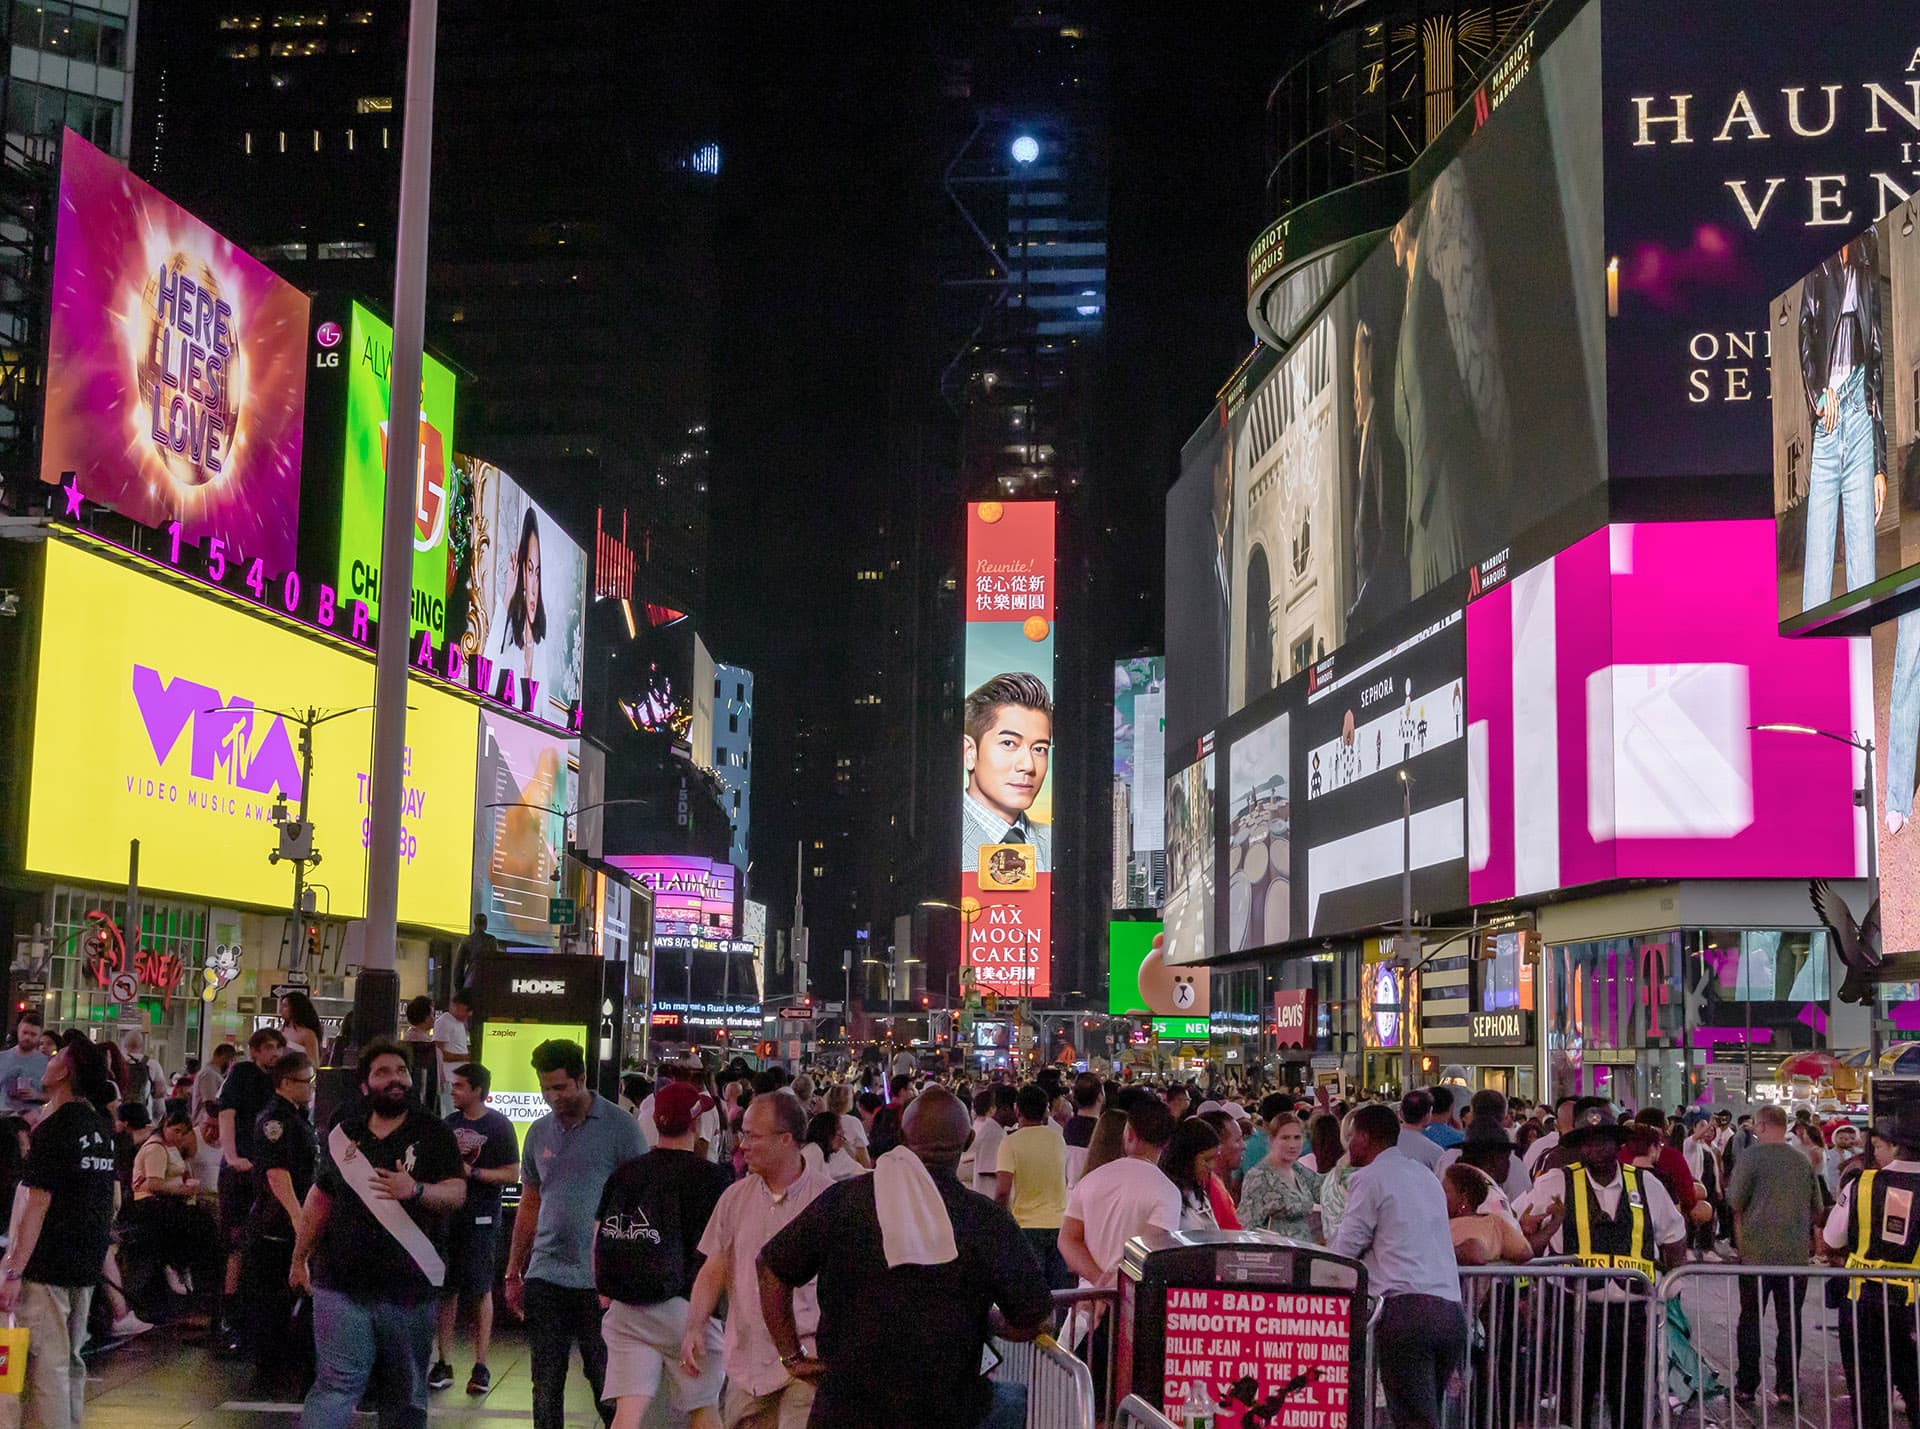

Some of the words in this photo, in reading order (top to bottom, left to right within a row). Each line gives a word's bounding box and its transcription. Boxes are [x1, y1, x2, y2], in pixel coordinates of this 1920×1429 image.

[1493, 31, 1534, 91] MARRIOTT
[1493, 61, 1529, 111] MARQUIS
[158, 263, 232, 356] HERE
[160, 327, 222, 412] LIES
[316, 352, 340, 368] LG
[151, 384, 223, 473] LOVE
[975, 559, 1034, 573] Reunite!
[1482, 548, 1510, 574] MARRIOTT
[975, 575, 1045, 592] 從心從新
[1482, 565, 1507, 588] MARQUIS
[168, 520, 300, 612] 1540
[318, 584, 540, 713] BRADWAY
[1360, 677, 1394, 708] SEPHORA
[126, 775, 178, 803] VIDEO
[188, 788, 236, 816] MUSIC
[676, 776, 689, 826] 1500
[989, 909, 1023, 925] MX
[970, 927, 1042, 944] MOON
[87, 909, 184, 1012] DSNEY
[972, 946, 1040, 963] CAKES
[511, 978, 566, 994] HOPE
[492, 1029, 517, 1037] zapier
[1473, 1015, 1520, 1038] SEPHORA
[494, 1094, 530, 1105] SCALE
[1167, 1291, 1208, 1309] JAM
[1222, 1293, 1265, 1312] BAD
[1276, 1296, 1350, 1316] MONEY
[1167, 1313, 1251, 1333] SMOOTH
[1255, 1317, 1350, 1338] CRIMINAL
[1166, 1336, 1204, 1355] BILLIE
[1207, 1338, 1241, 1357] JEAN
[1262, 1341, 1293, 1359] WANT
[1296, 1343, 1318, 1361] YOU
[1165, 1358, 1212, 1377] BLAME
[1219, 1360, 1233, 1378] IT
[1239, 1361, 1258, 1379] ON
[1264, 1362, 1292, 1381] THE
[1327, 1387, 1348, 1405] IT
[1282, 1409, 1326, 1428] ABOUT
[1329, 1411, 1348, 1429] US
